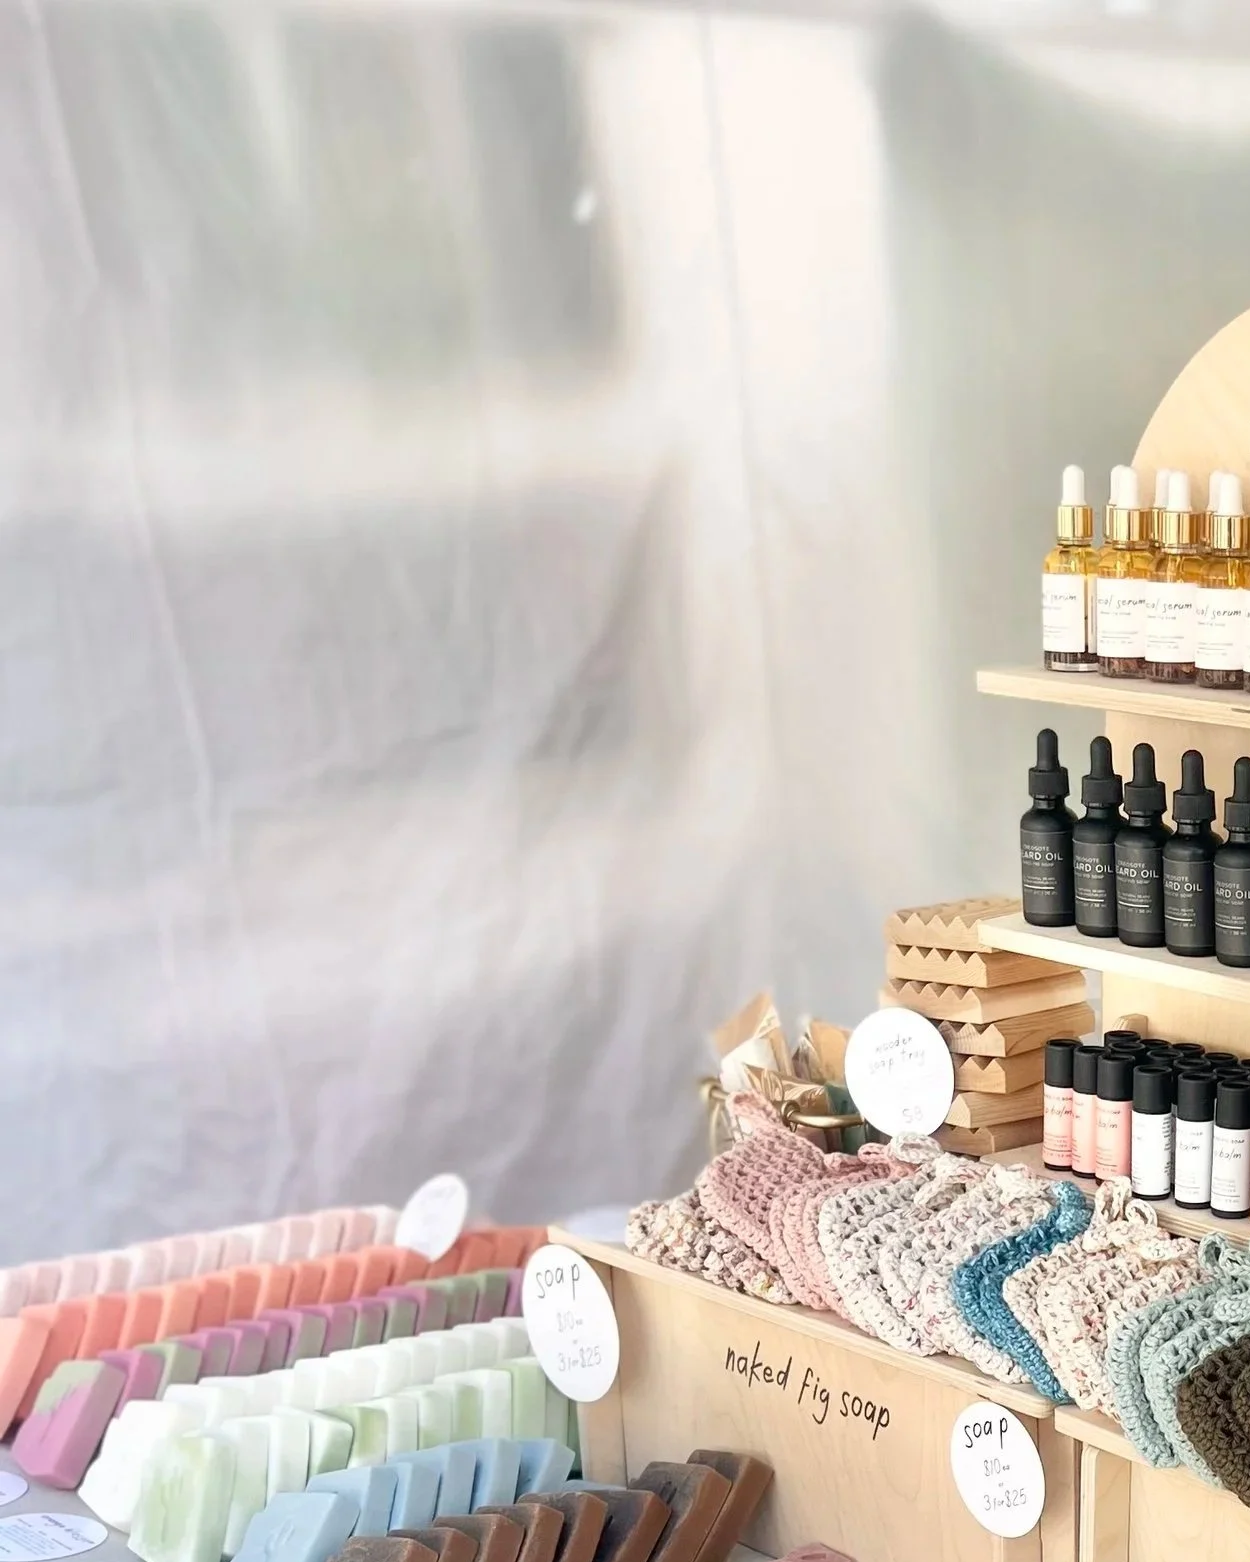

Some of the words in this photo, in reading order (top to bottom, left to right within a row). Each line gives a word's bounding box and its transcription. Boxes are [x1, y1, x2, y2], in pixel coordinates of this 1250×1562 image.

[1117, 598, 1146, 609] serum
[1163, 602, 1193, 613] serum
[1212, 608, 1242, 620] serum
[1045, 852, 1063, 862] OIL
[1095, 864, 1114, 873] OIL
[1116, 865, 1138, 878] EARD
[1141, 869, 1159, 879] OIL
[1184, 882, 1203, 892] OIL
[535, 1263, 581, 1300] soap
[725, 1341, 793, 1392] naked
[797, 1367, 830, 1425] fig
[839, 1390, 891, 1441] soap
[963, 1416, 1009, 1450] soap
[983, 1458, 1001, 1477] $10
[983, 1494, 992, 1512] 3
[1004, 1487, 1027, 1508] $25
